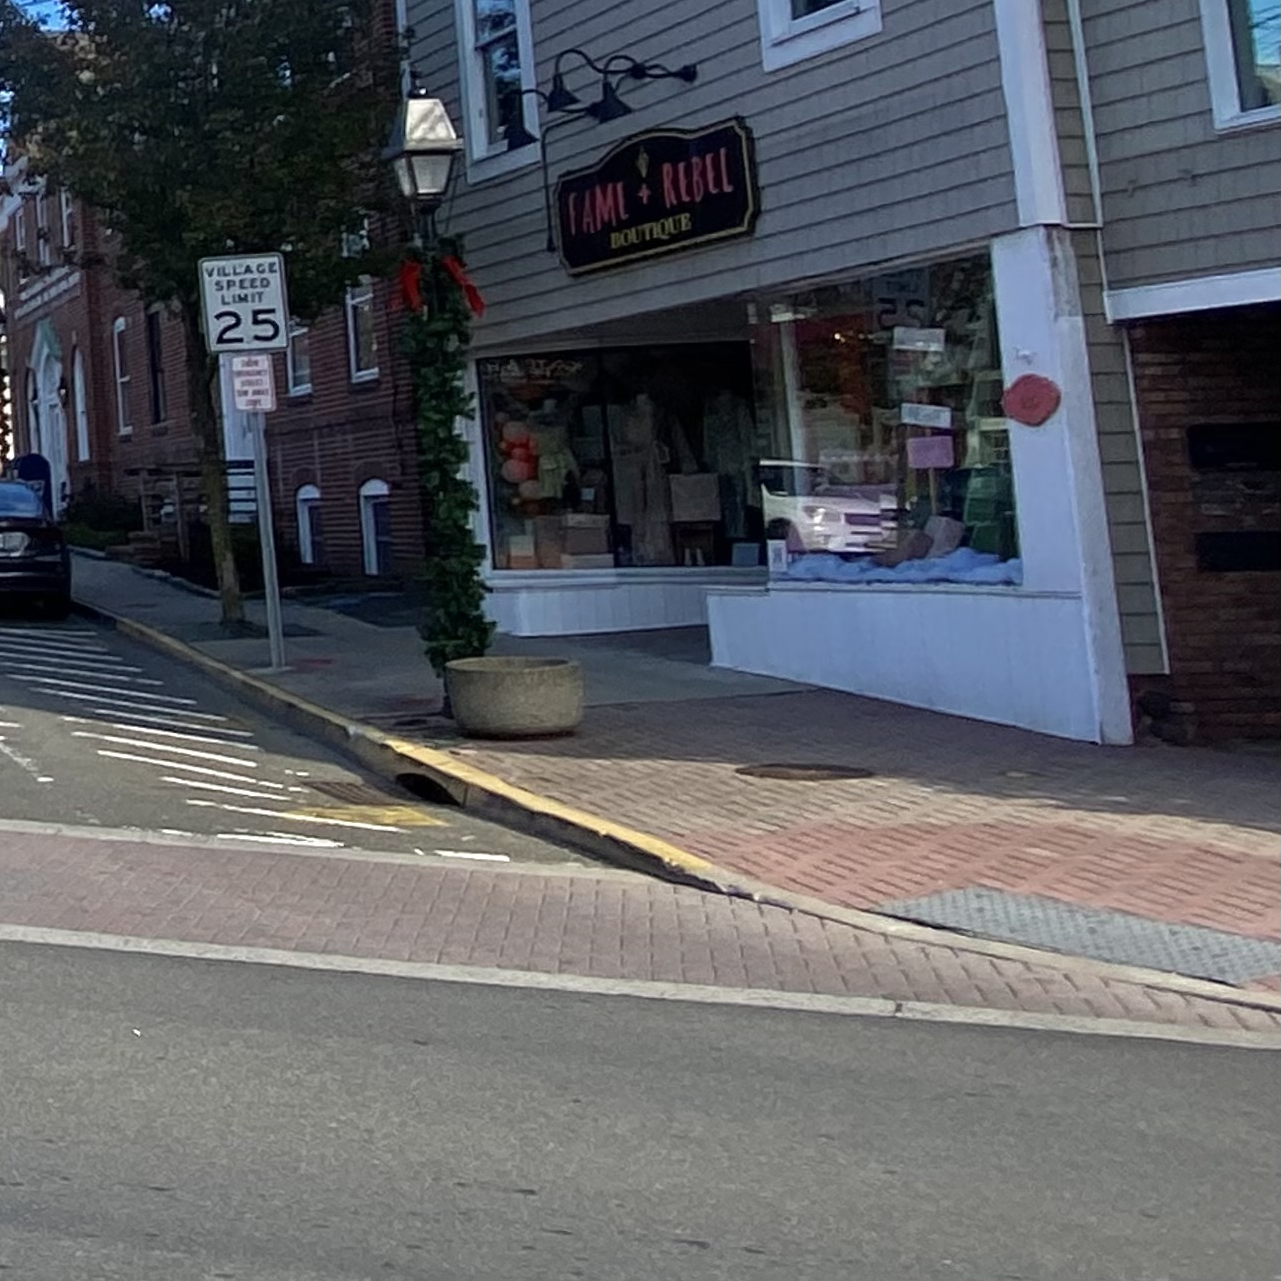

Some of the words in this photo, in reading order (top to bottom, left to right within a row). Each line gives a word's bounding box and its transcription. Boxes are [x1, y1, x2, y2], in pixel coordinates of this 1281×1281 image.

[567, 181, 629, 236] FAME
[661, 147, 734, 209] REBEL
[610, 213, 693, 249] BOUTIQUE
[205, 262, 278, 278] VILLAGE
[214, 277, 271, 292] SPEED
[221, 291, 264, 306] LIMIT
[214, 308, 280, 345] 25
